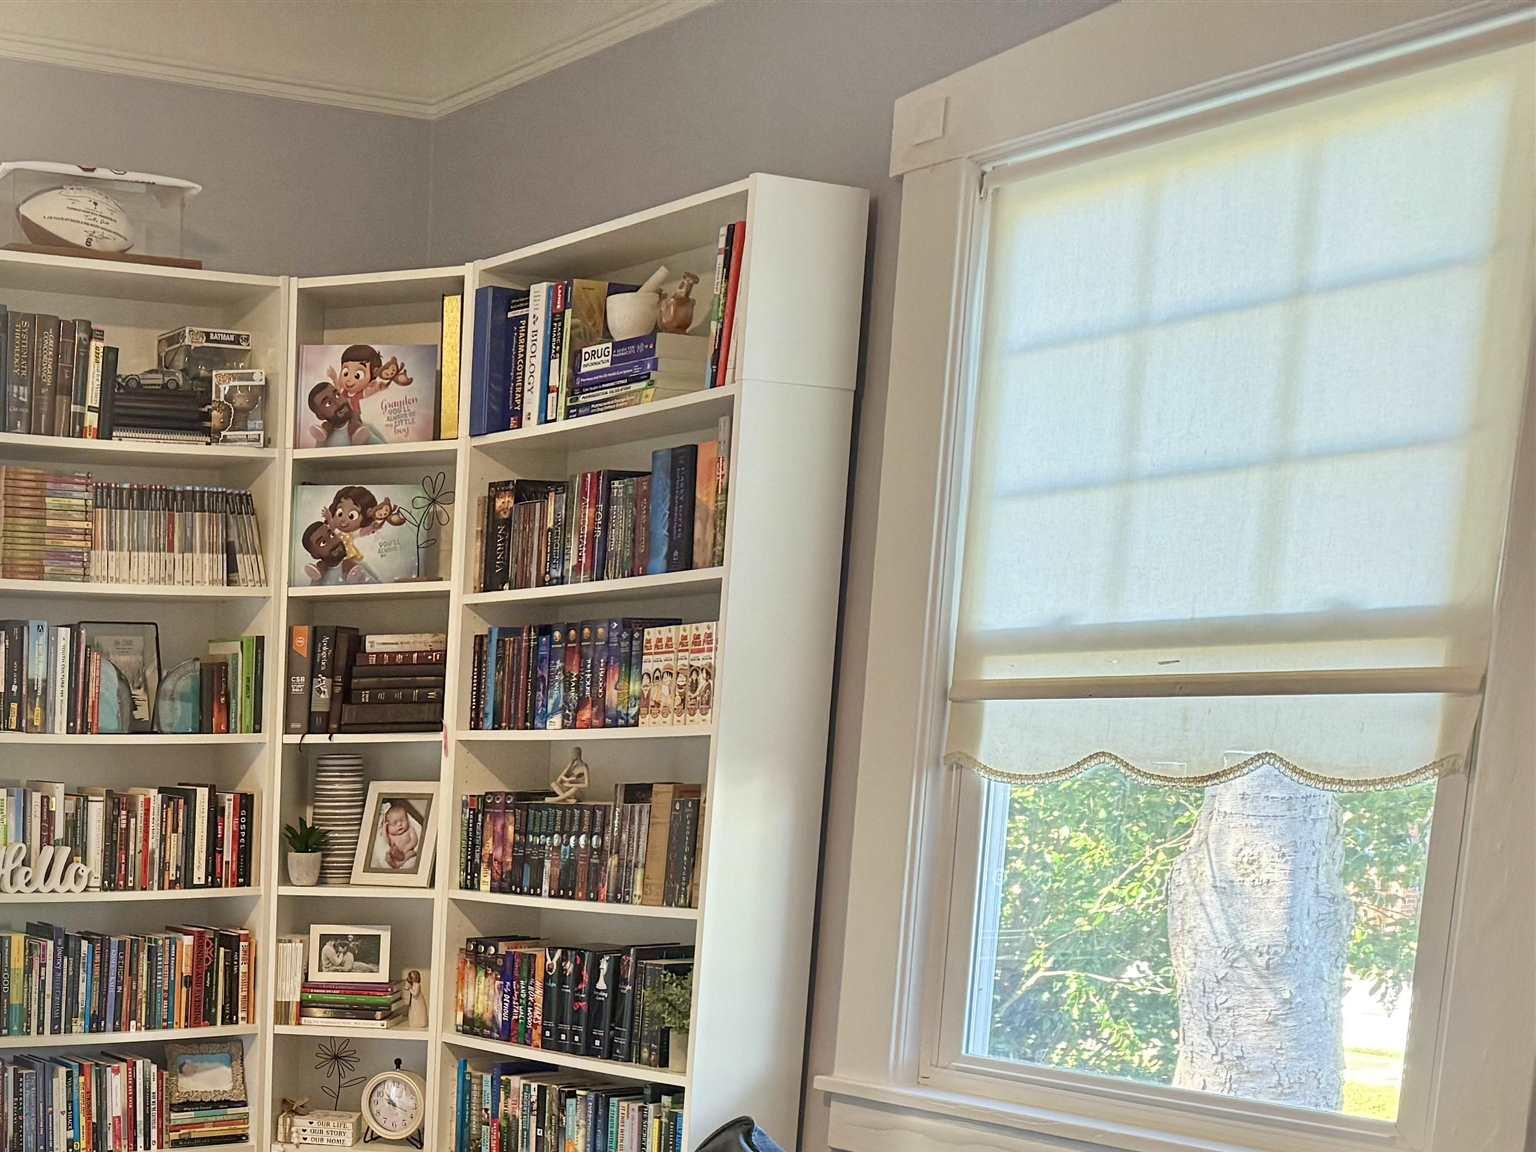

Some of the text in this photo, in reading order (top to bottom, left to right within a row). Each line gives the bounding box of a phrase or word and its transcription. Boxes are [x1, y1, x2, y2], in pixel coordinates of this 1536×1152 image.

[209, 332, 236, 342] BATMAN
[514, 319, 526, 411] PHARMACOTHERAPY
[527, 330, 539, 395] BIOLOGY
[584, 346, 611, 361] DRUG
[578, 496, 590, 564] ALLEGIANT
[594, 504, 604, 539] FOUR
[495, 525, 506, 574] NARNIA
[552, 511, 563, 571] DIVERGENT
[56, 946, 64, 970] Journey
[502, 993, 511, 1021] DEVIOUS
[518, 1005, 526, 1024] WALL
[532, 980, 543, 1025] NINE LIARS
[316, 1120, 331, 1128] OUR
[325, 1129, 347, 1137] STORY
